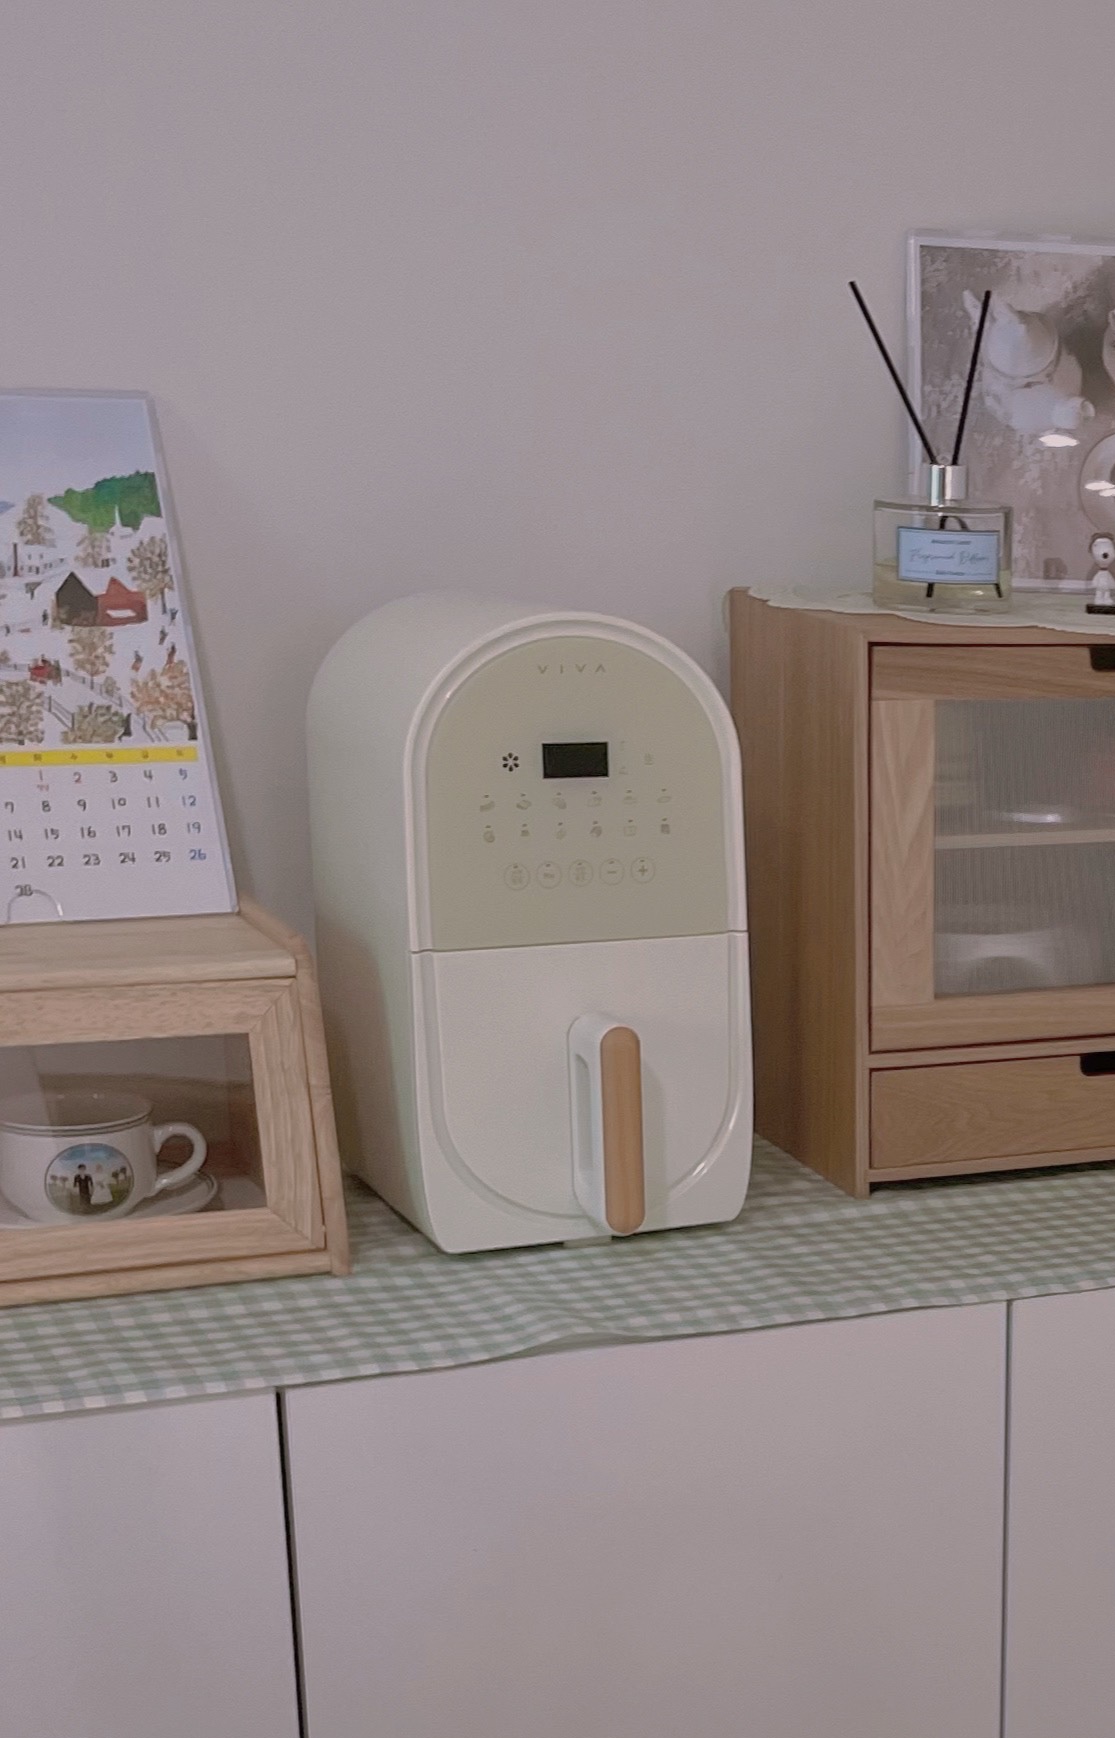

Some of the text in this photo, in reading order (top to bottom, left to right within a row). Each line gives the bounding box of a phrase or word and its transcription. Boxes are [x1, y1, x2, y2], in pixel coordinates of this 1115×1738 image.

[538, 664, 606, 674] VIVA
[73, 771, 83, 785] 2
[108, 770, 119, 784] 3
[143, 769, 154, 781] 4
[178, 767, 188, 781] 5
[4, 794, 197, 814] 7 8 9 10 11 12
[7, 821, 202, 842] 14 15 16 17 18 19
[10, 849, 206, 869] 21 22 23 24 25 26
